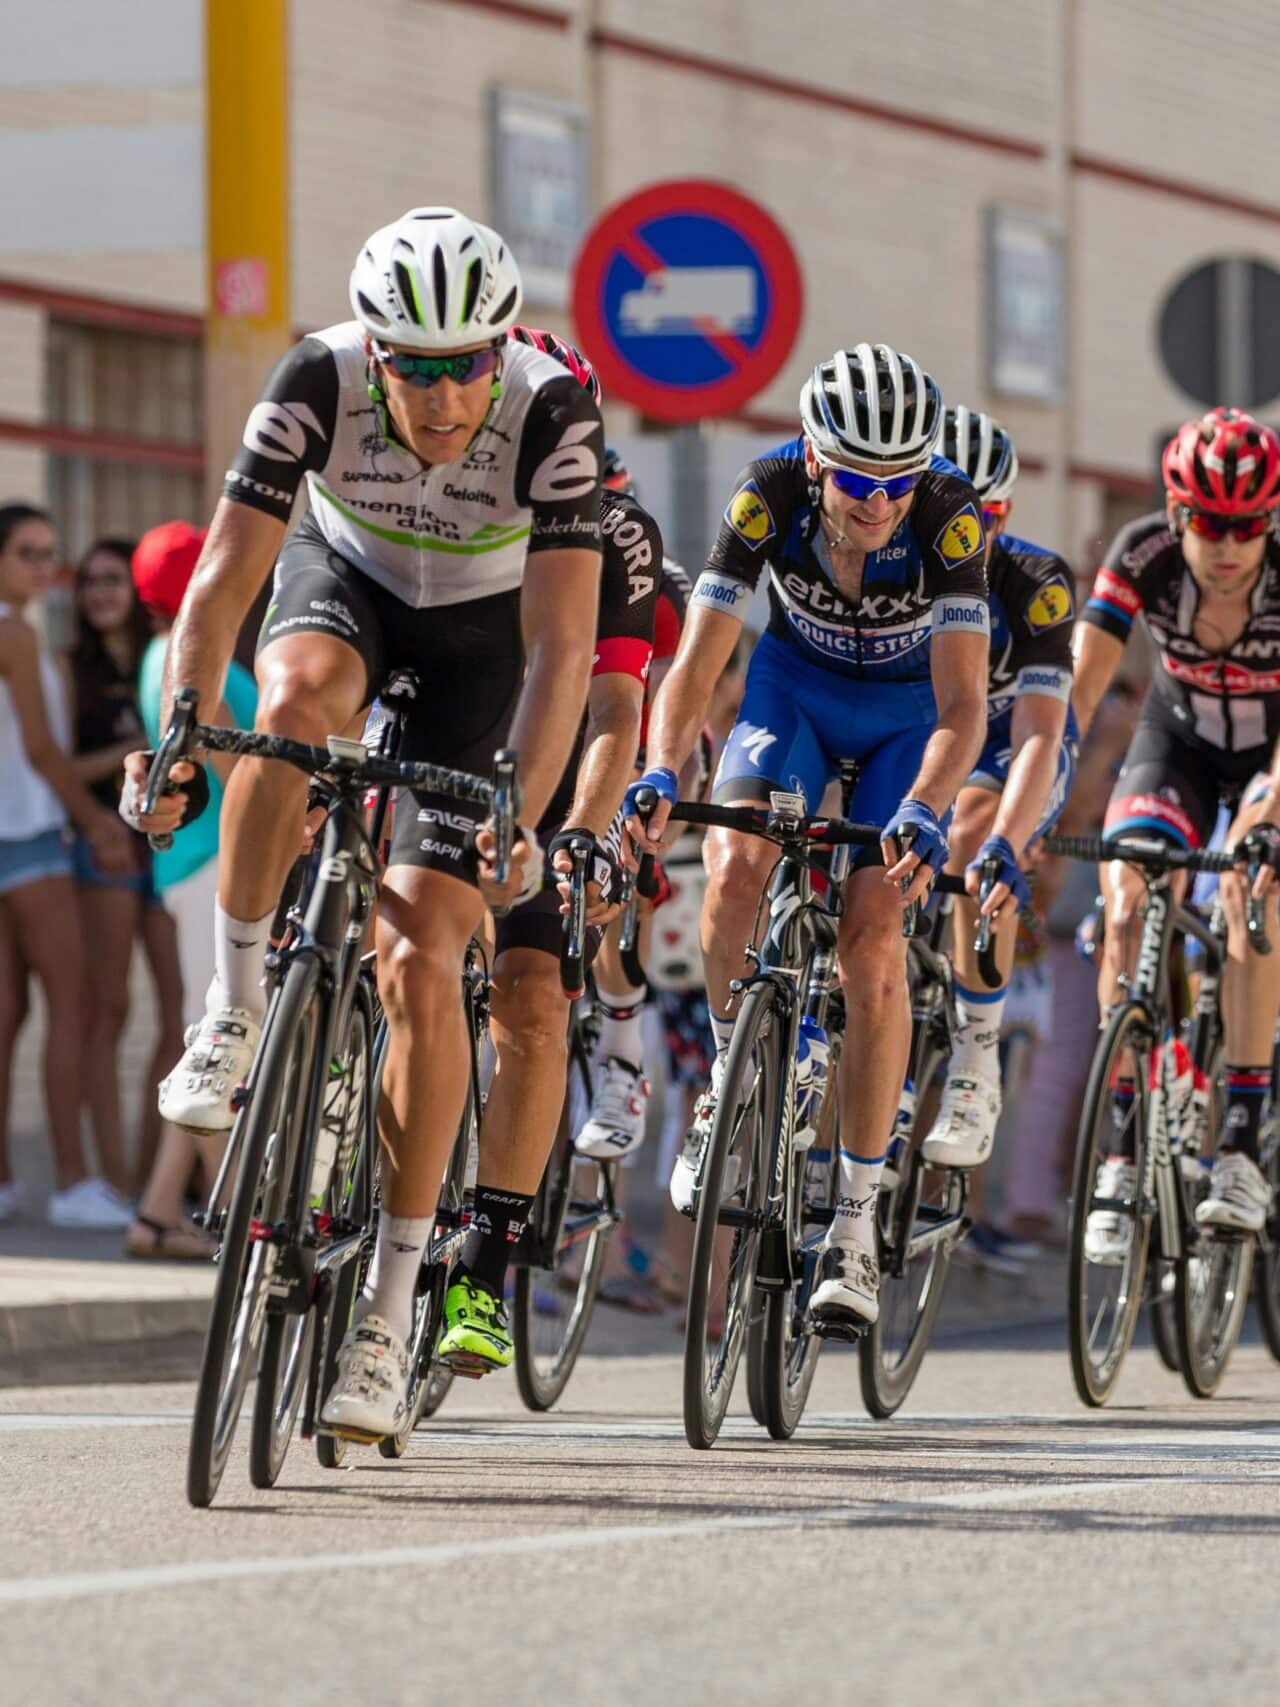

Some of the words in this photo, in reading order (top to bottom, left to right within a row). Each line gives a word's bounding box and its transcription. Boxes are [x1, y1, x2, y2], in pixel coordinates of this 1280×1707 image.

[602, 508, 654, 606] BORA
[1136, 894, 1167, 993] GIANT
[481, 1192, 526, 1207] CRAFT
[354, 1328, 392, 1349] SIDI
